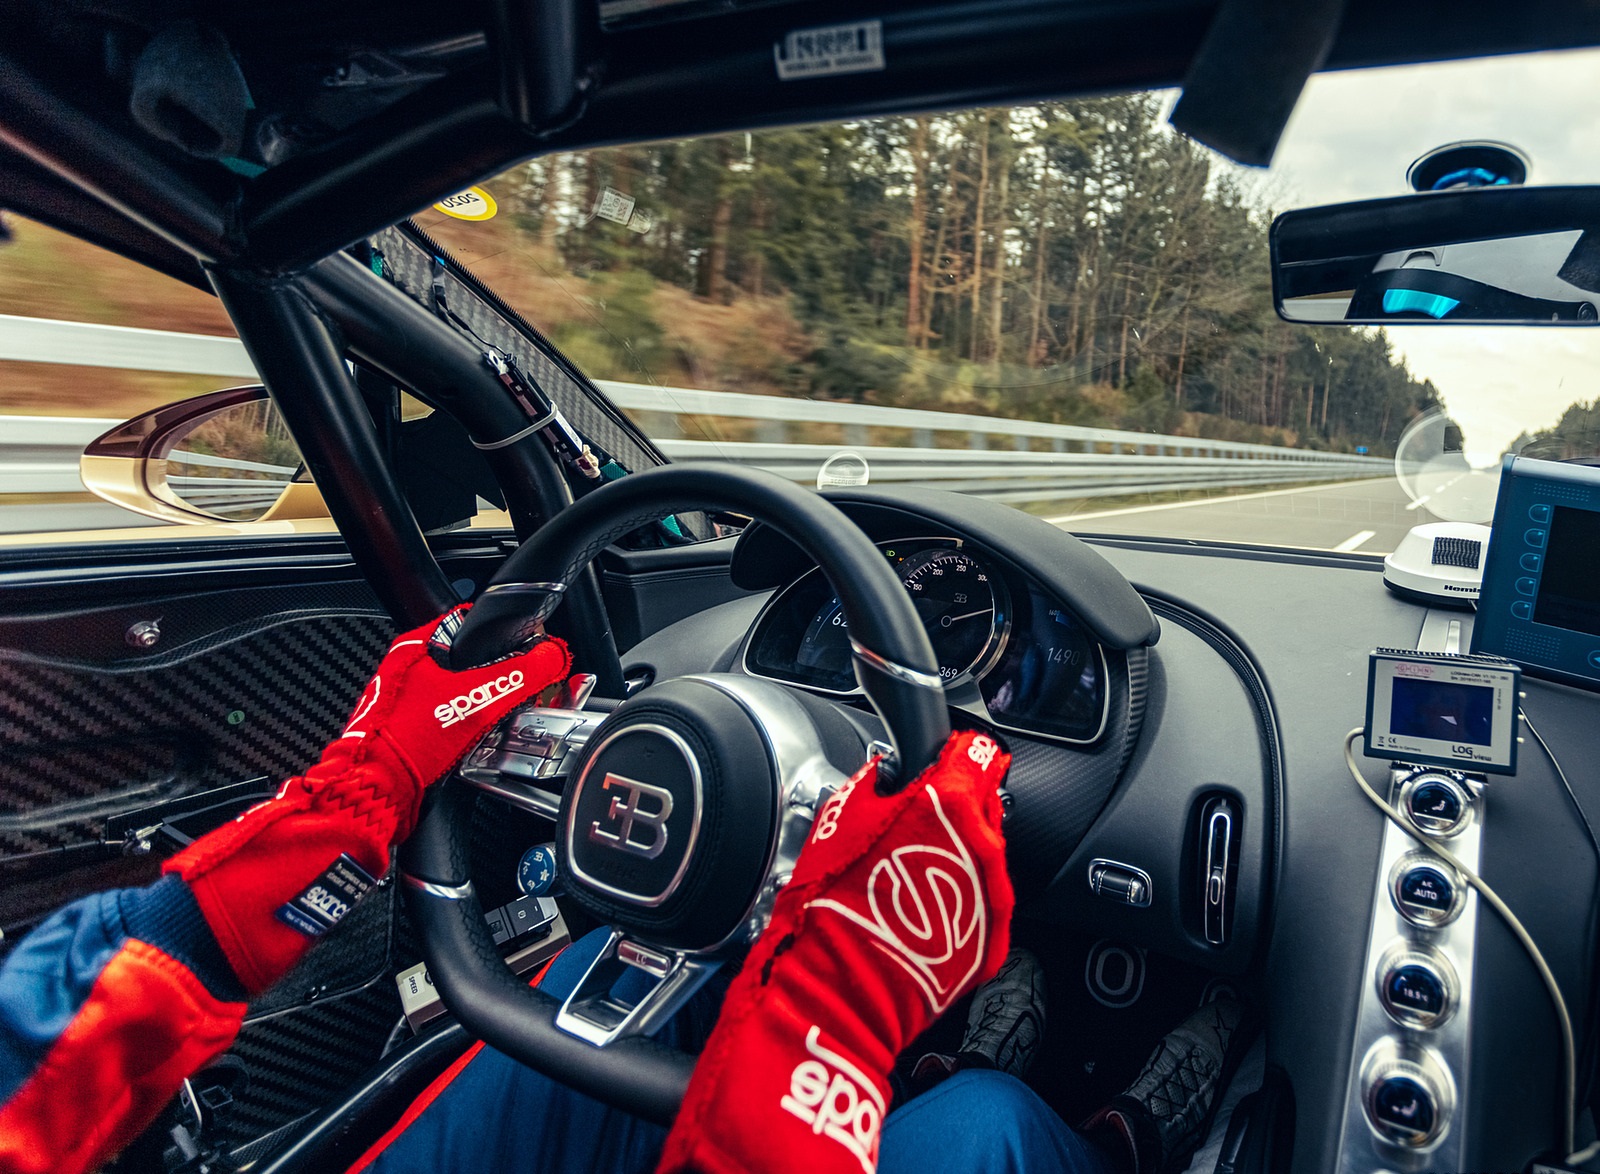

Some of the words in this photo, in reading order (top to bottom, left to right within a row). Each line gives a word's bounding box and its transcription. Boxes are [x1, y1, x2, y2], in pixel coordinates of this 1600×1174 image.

[932, 568, 943, 576] 200
[956, 564, 967, 572] 250
[912, 583, 923, 591] 150
[1047, 647, 1080, 666] 1490
[939, 666, 958, 679] 369
[434, 670, 525, 729] sparco
[1413, 888, 1438, 900] AUTO
[635, 953, 648, 965] LC
[409, 976, 418, 994] SPEED
